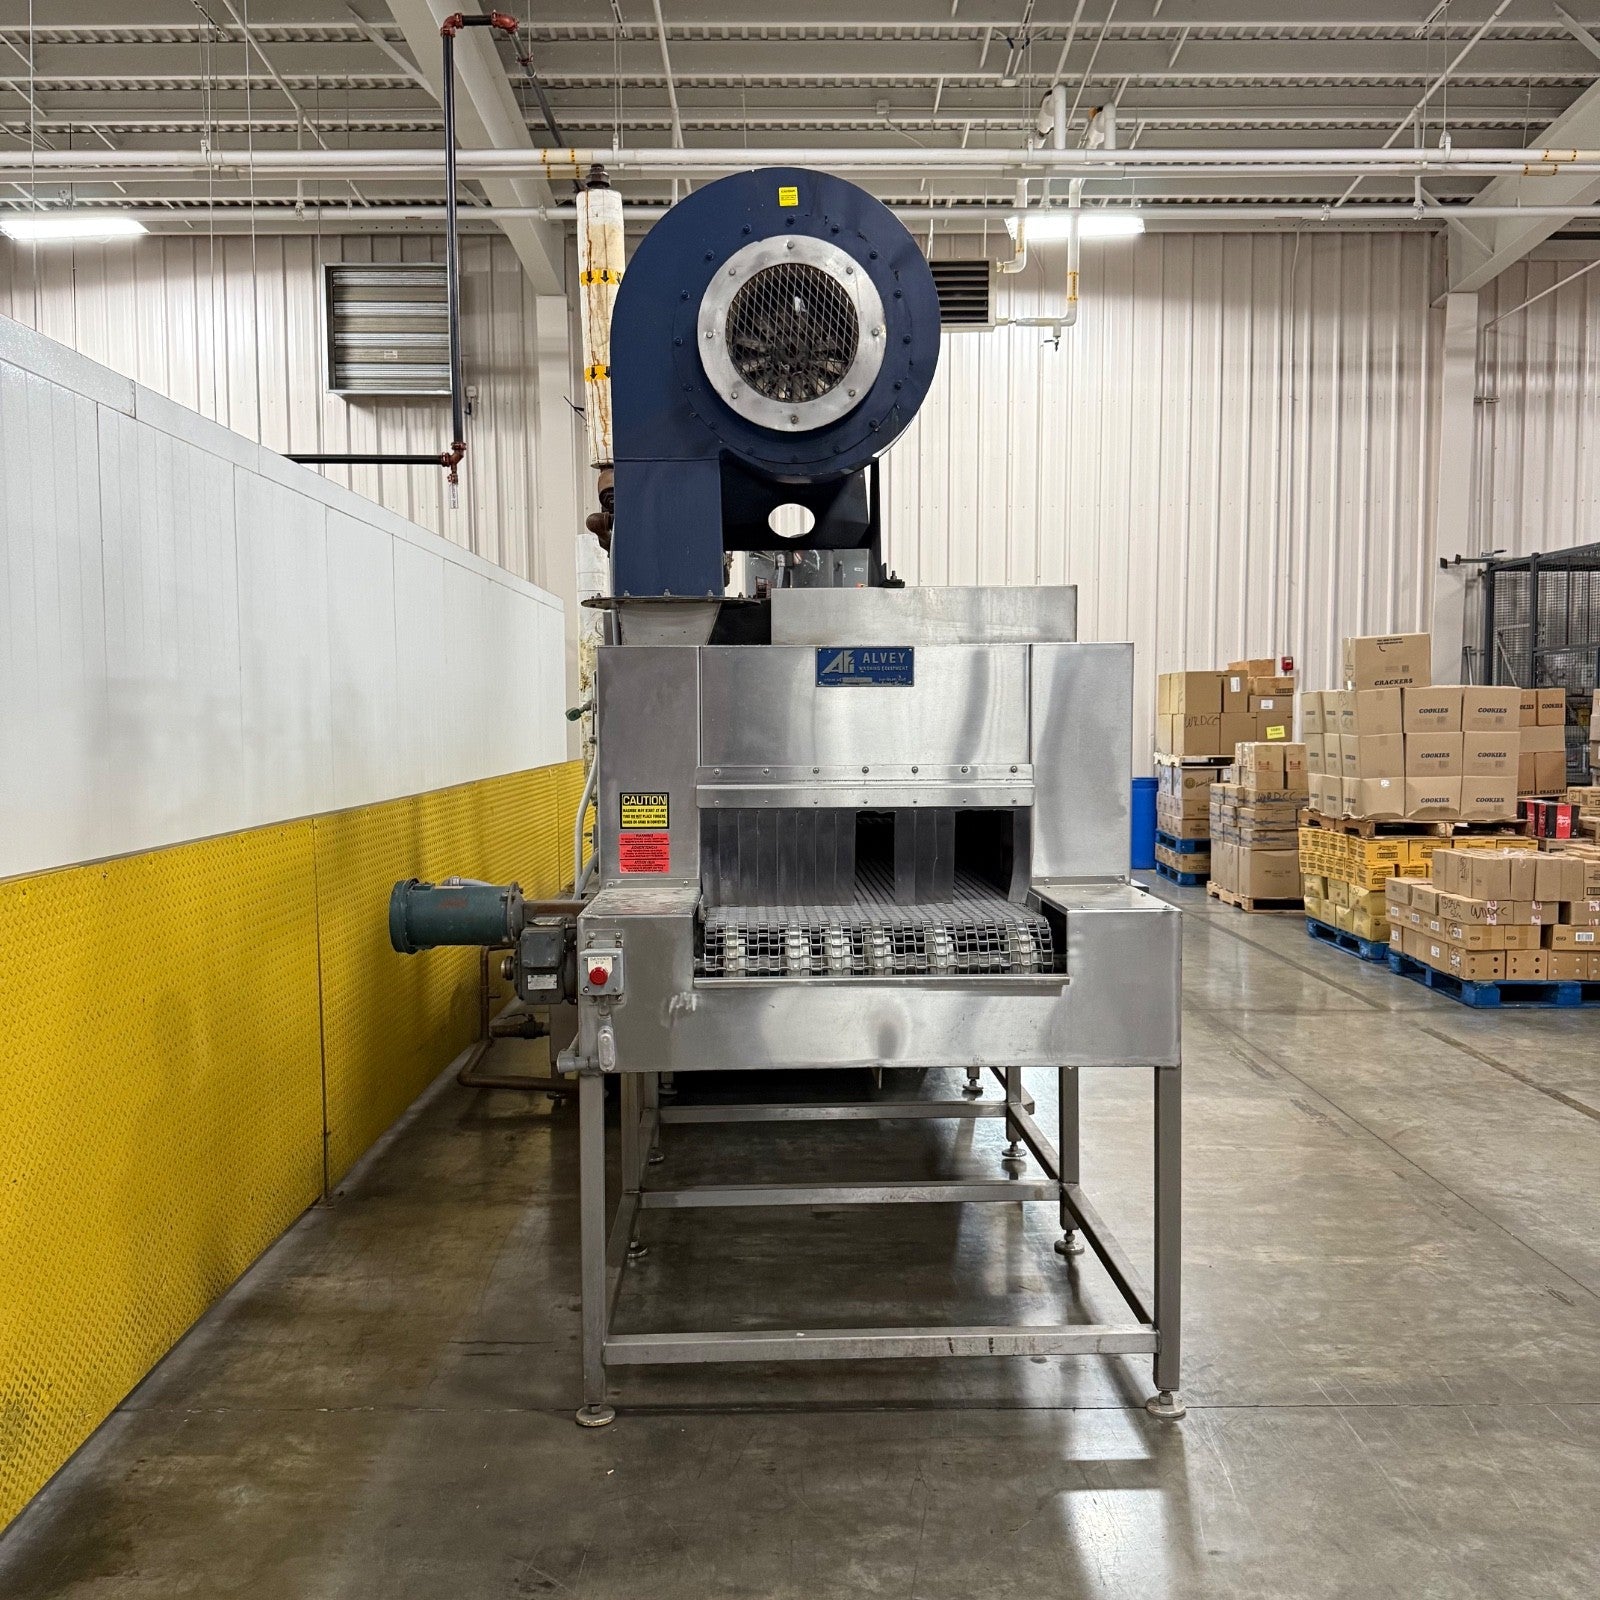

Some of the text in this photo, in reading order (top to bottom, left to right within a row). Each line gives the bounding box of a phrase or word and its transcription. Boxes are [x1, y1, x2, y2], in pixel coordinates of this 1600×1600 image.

[863, 652, 906, 664] ALVEY
[1374, 678, 1413, 686] CRACKERS
[623, 795, 666, 805] CAUTION
